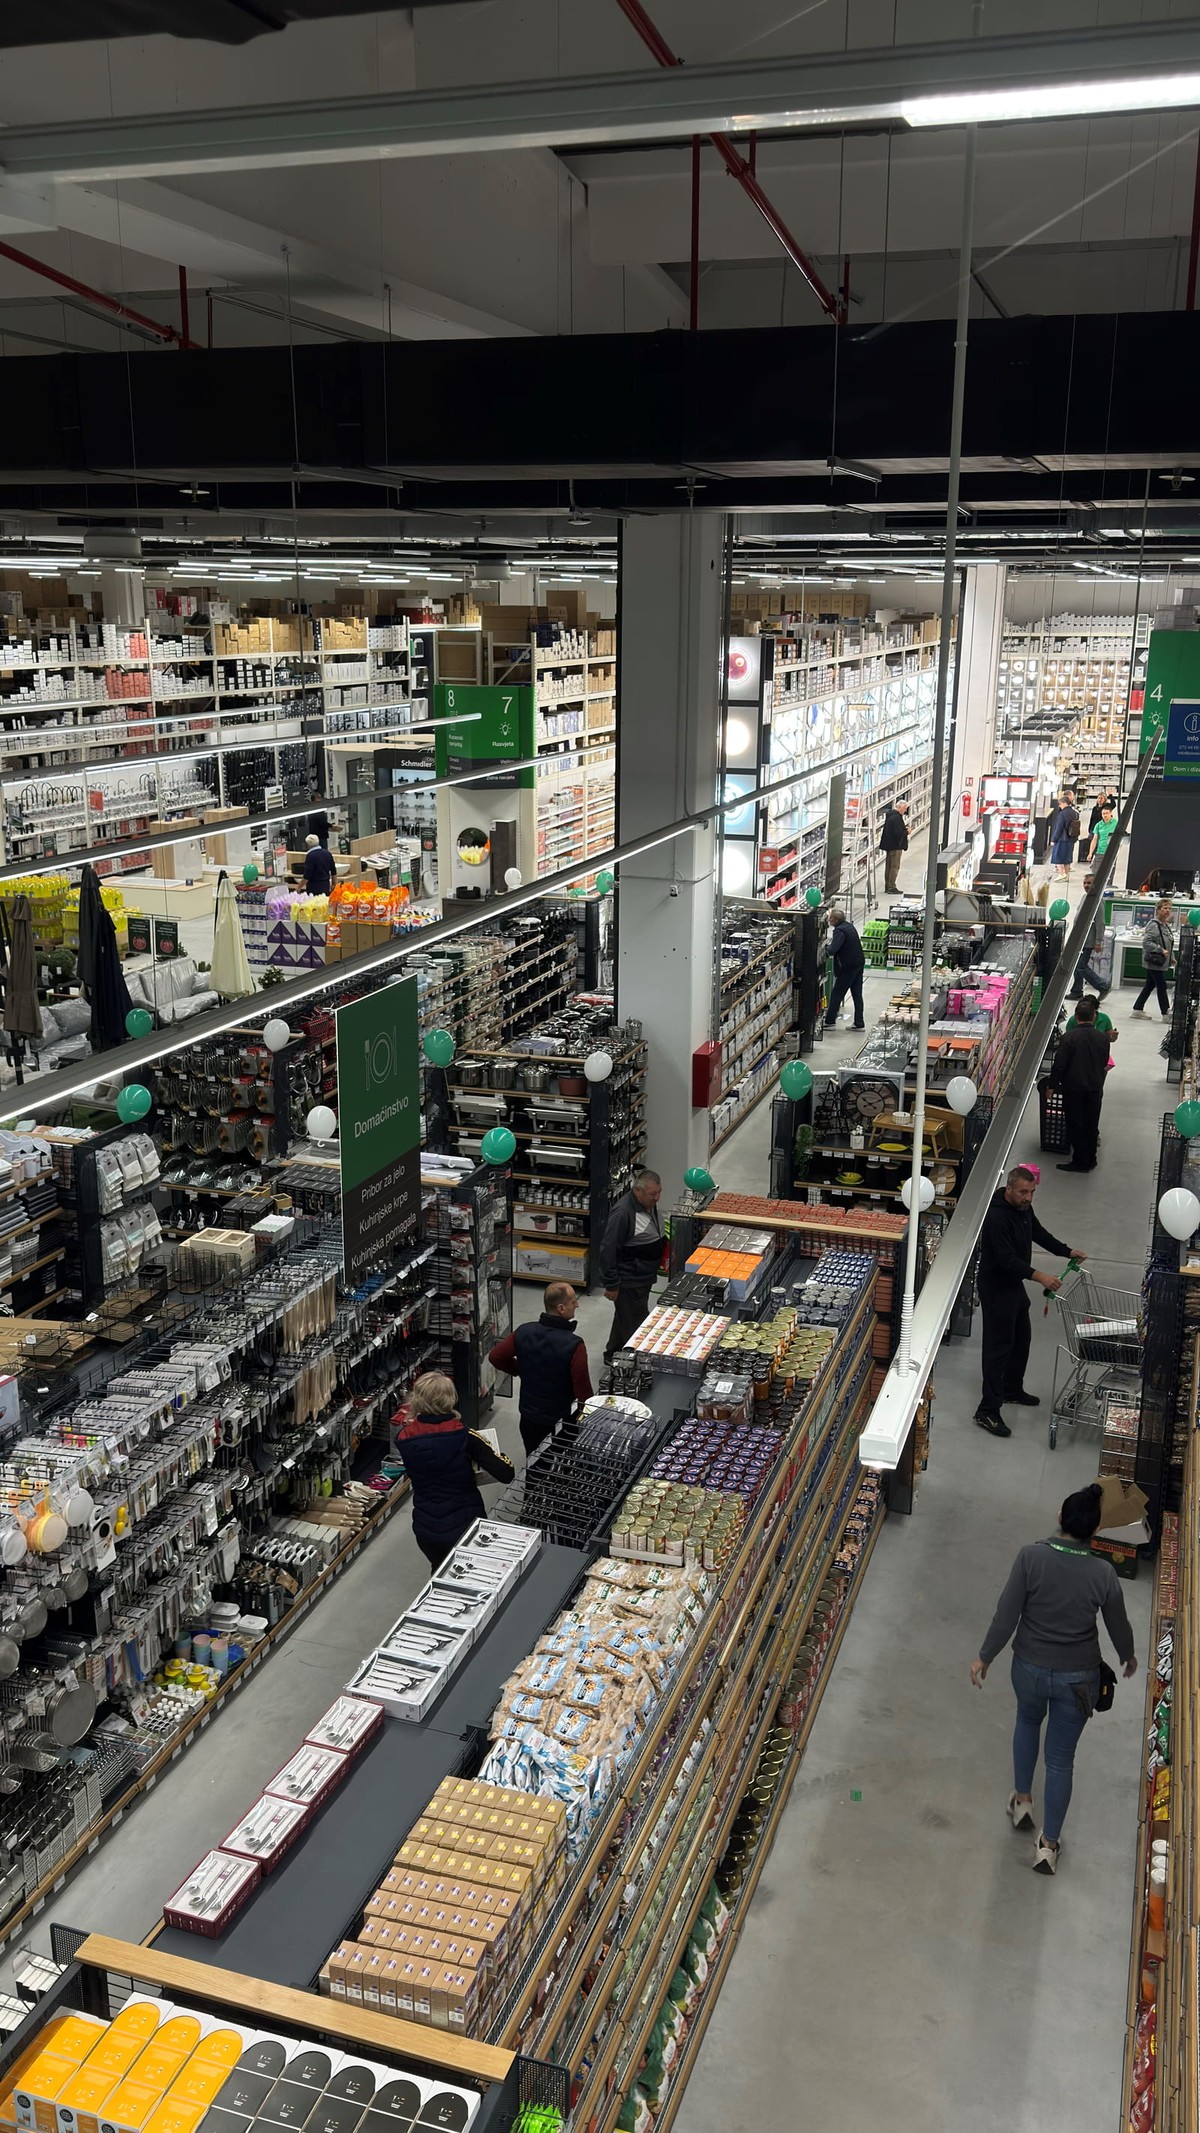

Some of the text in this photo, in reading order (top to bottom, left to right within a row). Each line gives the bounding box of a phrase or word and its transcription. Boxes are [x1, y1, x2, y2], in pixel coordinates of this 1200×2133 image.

[447, 689, 455, 707] 8
[501, 696, 513, 714] 7
[1150, 683, 1163, 702] 4
[401, 760, 433, 768] Schmidler
[354, 1096, 409, 1138] Domaćinstvo
[361, 1165, 405, 1203] Pribor za jelo
[359, 1191, 408, 1234] Kuhinjske krpe
[351, 1212, 417, 1270] Kuhinjska pomagala
